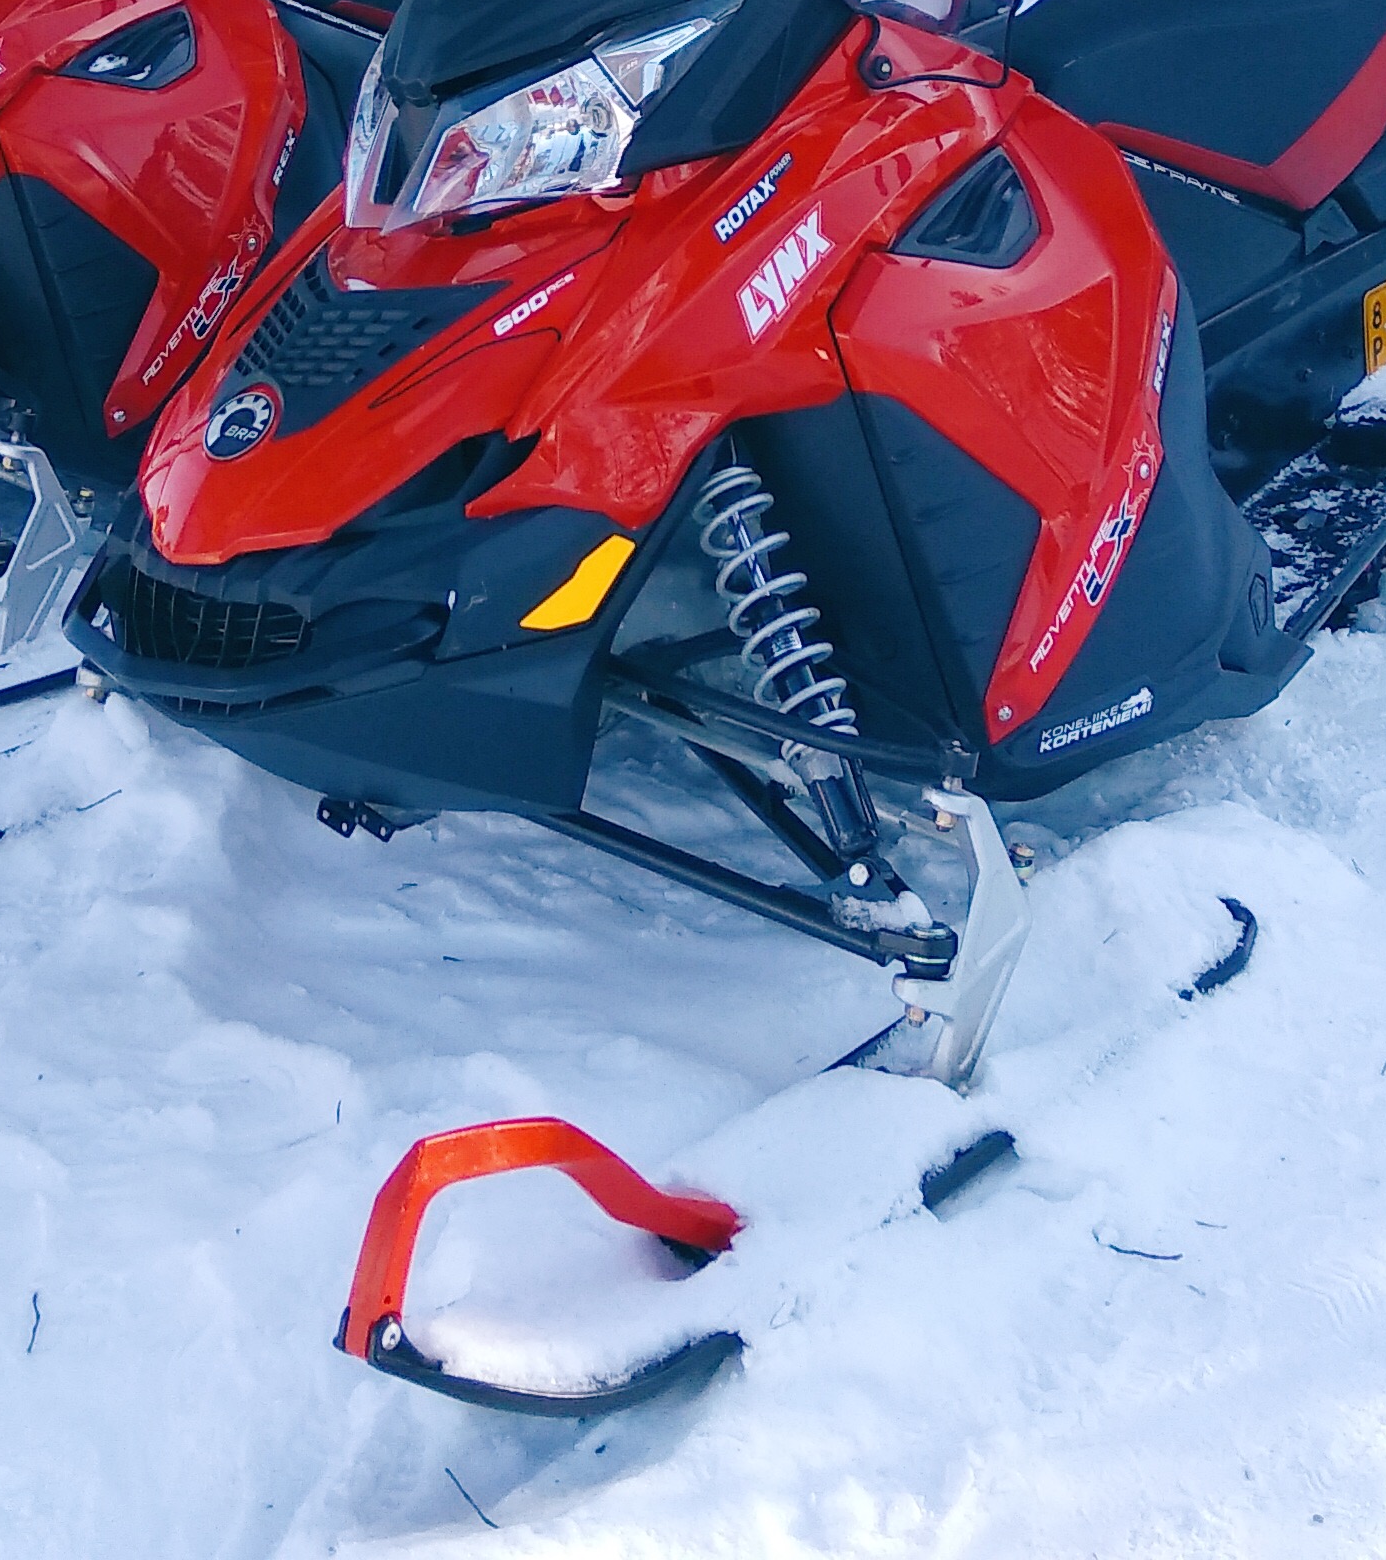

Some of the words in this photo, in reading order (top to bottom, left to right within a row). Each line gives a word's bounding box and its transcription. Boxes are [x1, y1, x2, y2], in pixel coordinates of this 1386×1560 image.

[714, 173, 776, 242] ROTAX
[1153, 162, 1240, 204] FRAME
[736, 201, 835, 344] LYNX
[142, 264, 222, 386] ADVENTURE
[493, 290, 549, 337] 600
[224, 424, 259, 442] BRP
[1029, 503, 1114, 672] ADVENTURE
[1039, 700, 1153, 754] KORTENIEMI
[1041, 704, 1119, 741] KONELIIKE
